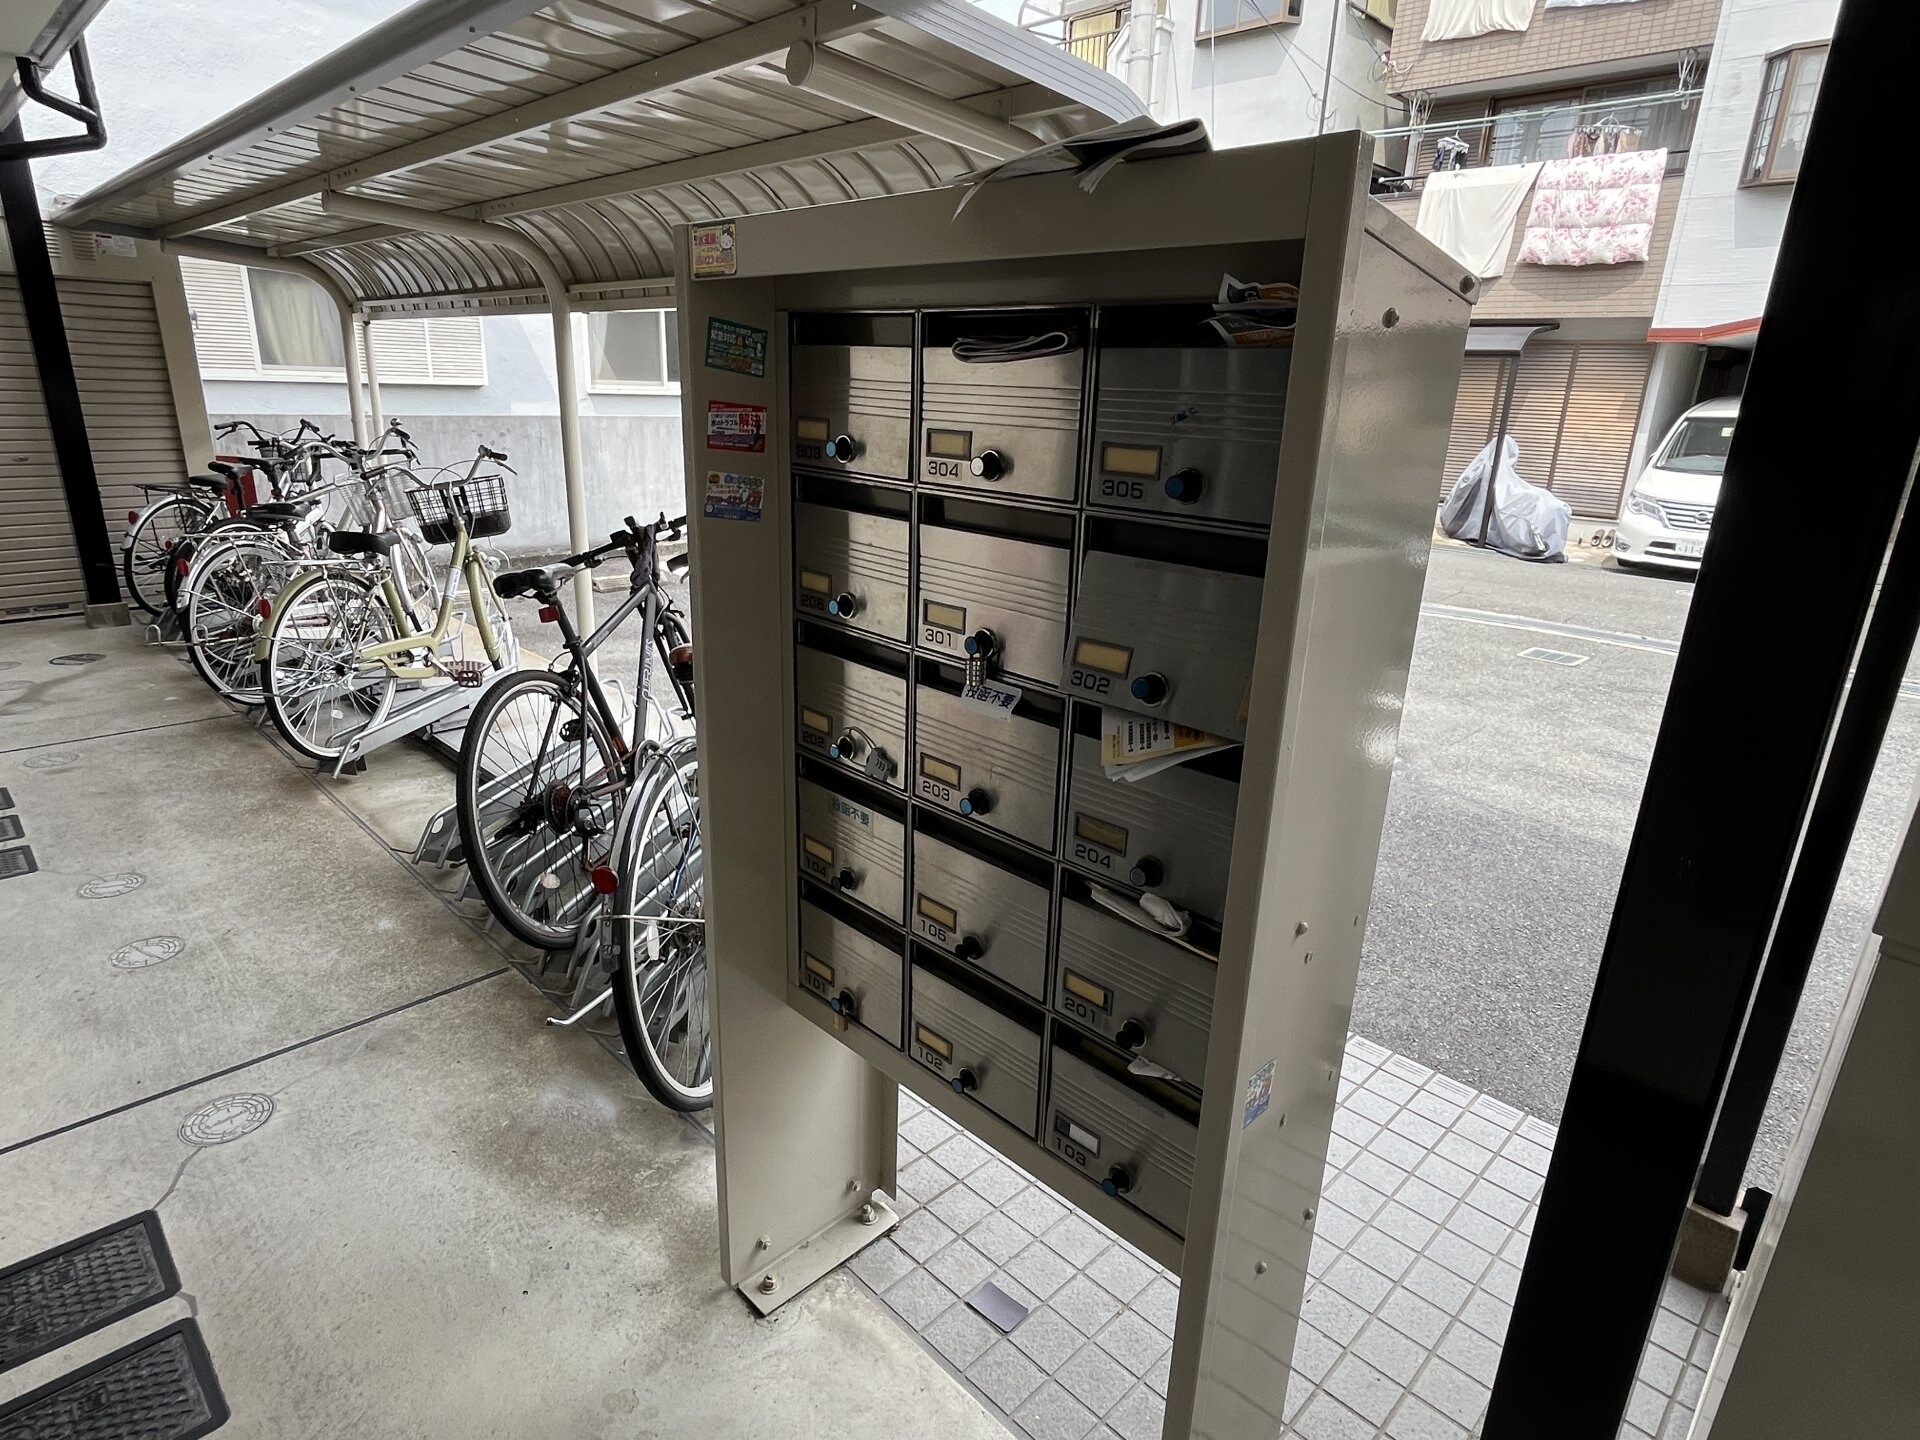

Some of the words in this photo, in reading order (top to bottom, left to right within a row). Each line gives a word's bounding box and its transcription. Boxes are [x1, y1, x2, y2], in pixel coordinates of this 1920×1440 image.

[928, 460, 959, 478] 304
[1102, 479, 1144, 500] 305
[925, 628, 952, 647] 301
[1070, 669, 1111, 694] 302
[965, 686, 1017, 709] 投函不要
[802, 731, 825, 749] 202
[922, 780, 950, 802] 203
[806, 856, 826, 878] 104
[1074, 843, 1111, 869] 204
[921, 919, 947, 942] 105
[807, 973, 826, 994] 101
[1064, 996, 1095, 1024] 201
[918, 1046, 943, 1071] 102
[1056, 1136, 1087, 1166] 103
